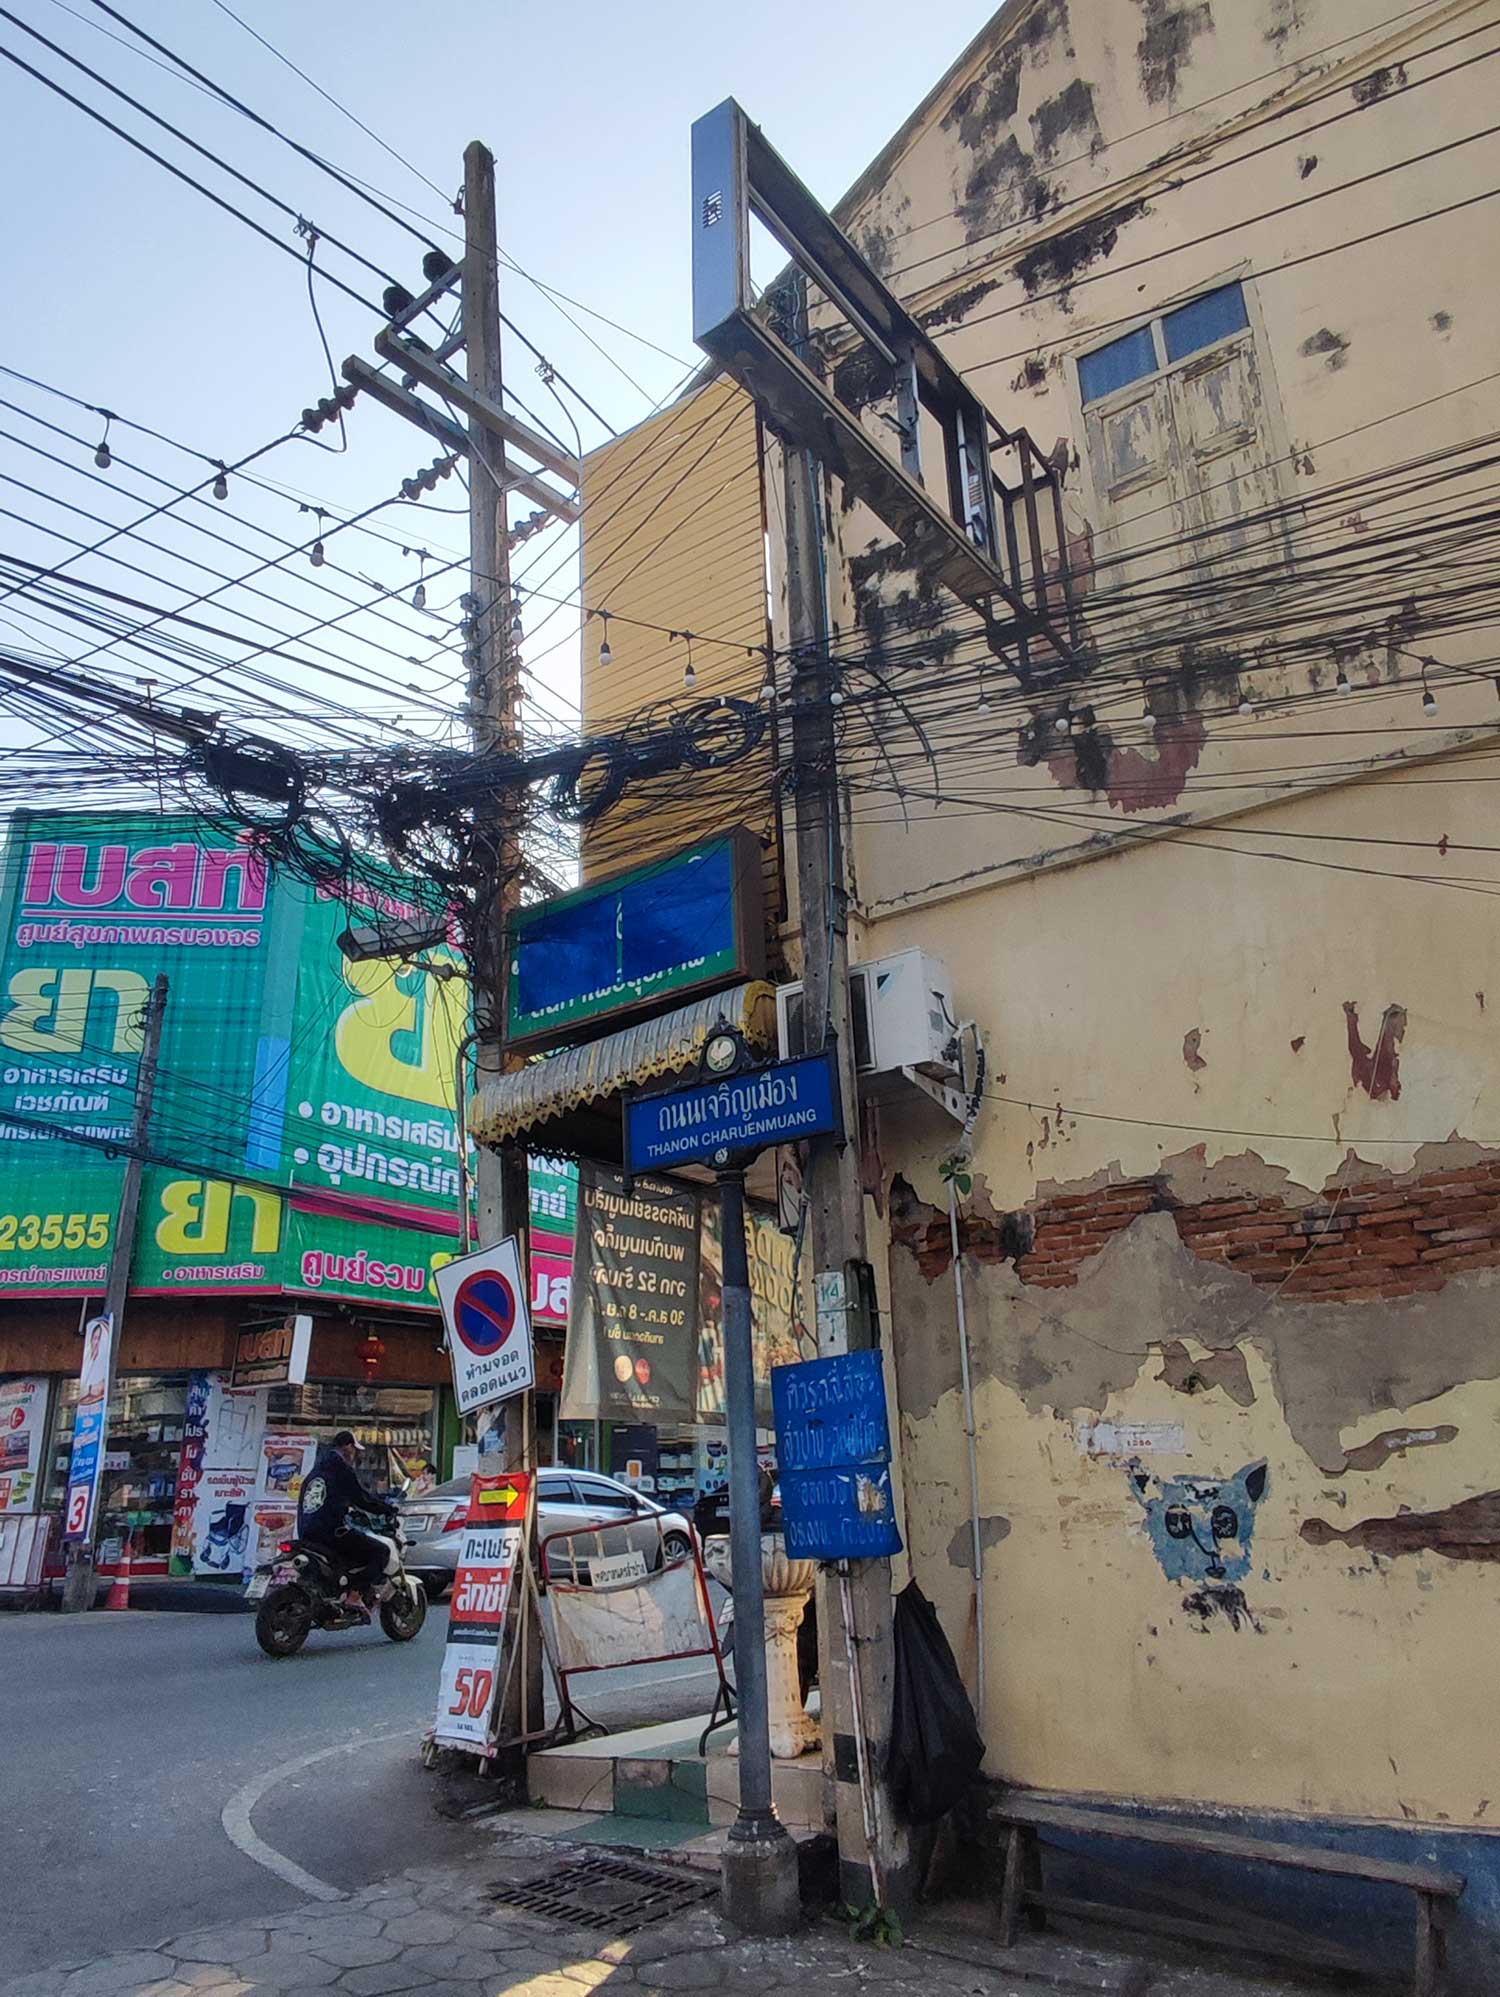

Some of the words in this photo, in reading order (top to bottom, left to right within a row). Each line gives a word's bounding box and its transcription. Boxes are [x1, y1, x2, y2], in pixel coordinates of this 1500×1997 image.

[17, 920, 261, 949] ศูนย์สุขภาพครบวงจร
[0, 968, 151, 1053] ยา
[659, 1071, 798, 1131] ถนนเจริญเมือง
[647, 1135, 699, 1158] THANON
[701, 1108, 817, 1146] CHARUENMUANG
[0, 1213, 110, 1250] 23555
[155, 1181, 283, 1254] ยา
[175, 1262, 265, 1281] อาหารเสริม
[302, 1250, 425, 1292] ศูนย์รวม
[461, 1366, 527, 1403] ตลอดแนว
[466, 1349, 520, 1381] ห้ามจอด
[69, 1495, 86, 1532] 3
[449, 1667, 493, 1718] 50
